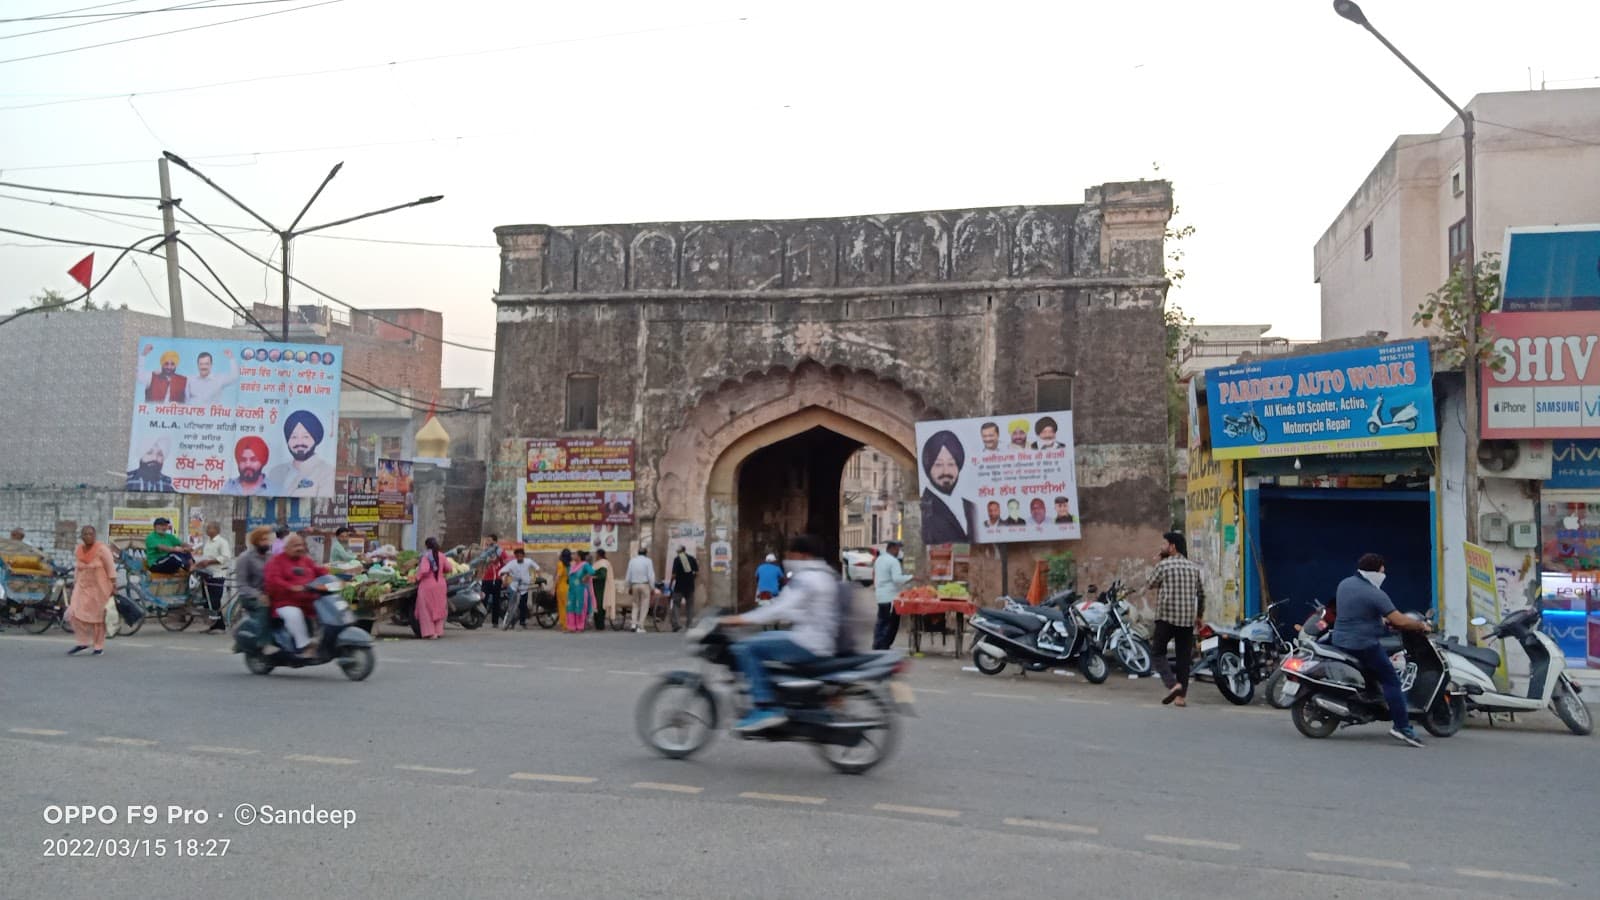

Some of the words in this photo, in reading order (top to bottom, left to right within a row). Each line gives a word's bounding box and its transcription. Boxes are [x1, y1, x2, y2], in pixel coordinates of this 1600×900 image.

[1492, 334, 1598, 383] SHIV
[296, 384, 312, 395] CM
[1218, 375, 1293, 404] PARDEEP
[1296, 368, 1345, 397] AUTO
[1346, 360, 1416, 391] WORKS
[155, 403, 206, 418] ਅਜੀਤਪਾਲ
[209, 404, 232, 418] ਸਿੰਘ
[235, 405, 265, 420] ਕੋਹਲੀ
[268, 406, 279, 425] ਨੂੰ
[1263, 404, 1274, 418] All
[1275, 402, 1296, 417] Kinds
[1297, 402, 1306, 415] Of
[1306, 400, 1339, 414] Scooter,
[1340, 396, 1368, 411] Activa,
[1501, 400, 1527, 414] iPhone
[1536, 401, 1580, 414] SAMSUNG
[149, 419, 181, 430] M.L.A.
[1282, 420, 1325, 436] Motorcycle
[1325, 418, 1351, 432] Repair
[175, 453, 225, 472] ਲੱਖ-ਲੱਖ
[172, 473, 225, 492] ਵਧਾਈਆਂ
[1021, 481, 1066, 495] ਵਧਾਈਆਂ
